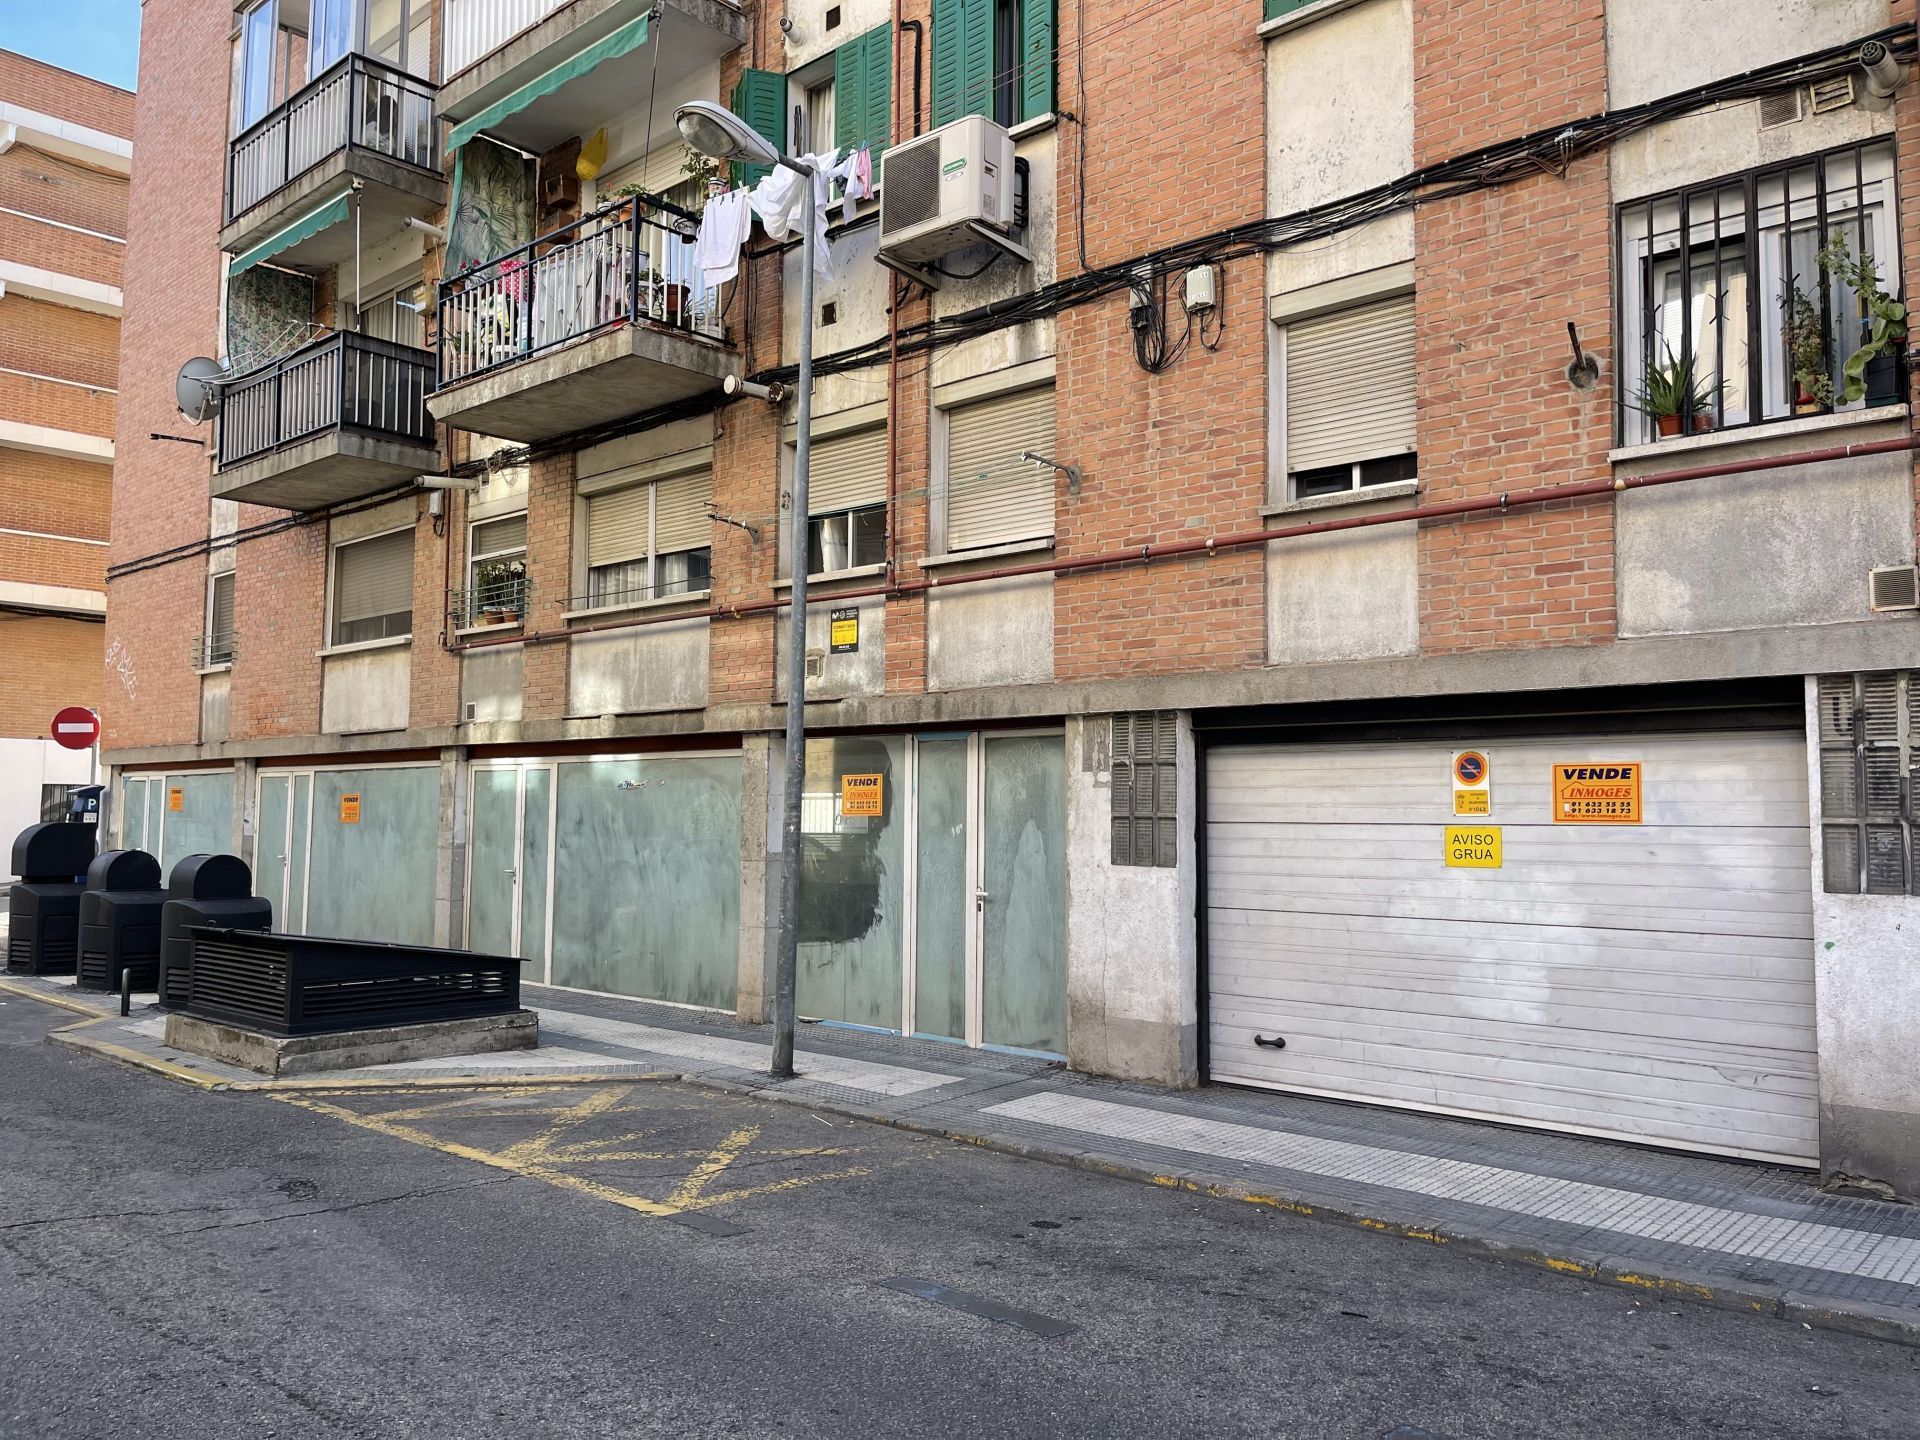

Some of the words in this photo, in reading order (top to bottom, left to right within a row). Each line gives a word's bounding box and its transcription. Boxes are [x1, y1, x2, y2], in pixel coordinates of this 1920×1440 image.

[1563, 768, 1633, 780] VENDE
[847, 778, 878, 786] VENDE
[1568, 787, 1632, 798] INMOGES
[87, 798, 97, 810] P
[1452, 834, 1494, 846] AVISO
[1453, 848, 1494, 860] GRUA
